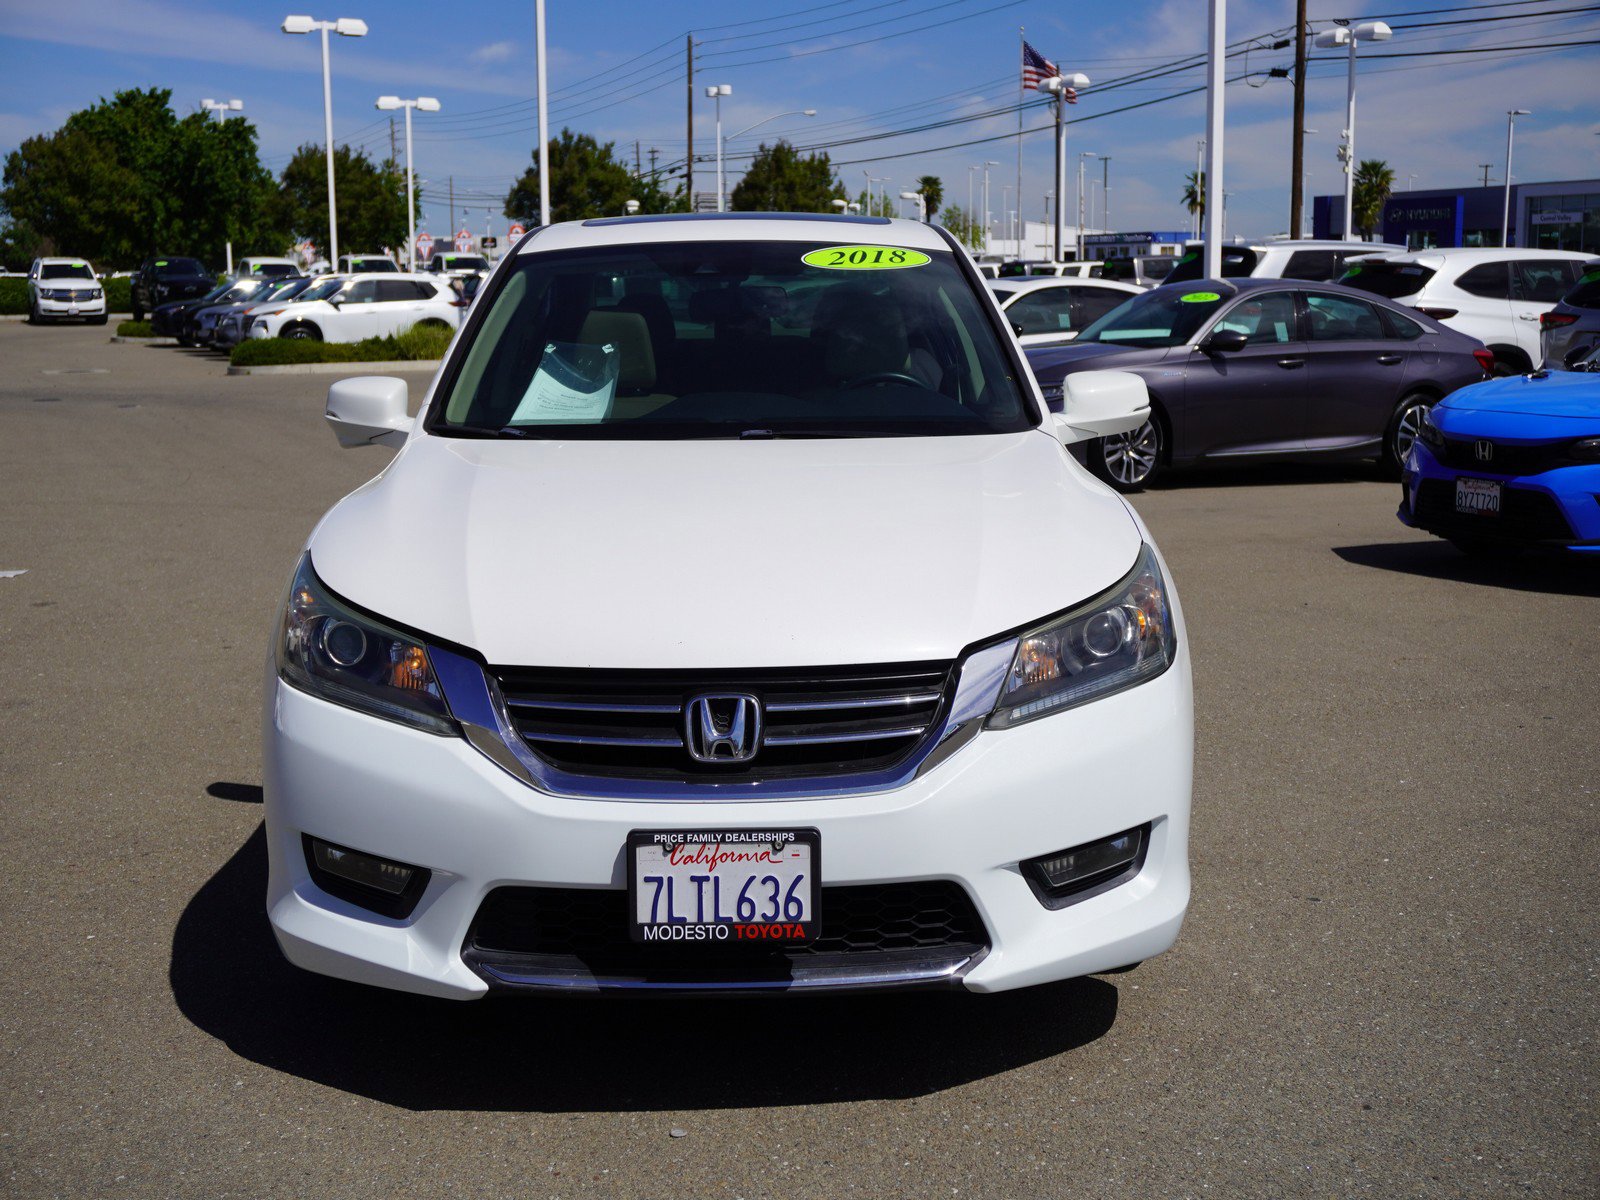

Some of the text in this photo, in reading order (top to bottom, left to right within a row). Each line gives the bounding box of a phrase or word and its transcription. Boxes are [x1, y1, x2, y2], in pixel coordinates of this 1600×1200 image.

[828, 250, 907, 266] 2018
[1457, 491, 1498, 511] 8YZT720
[654, 832, 795, 843] PRICE FAMILY DEALERSHIPS
[670, 843, 783, 872] California
[643, 874, 804, 924] 7LTL636
[644, 924, 806, 940] MODESTO TOYOTA
